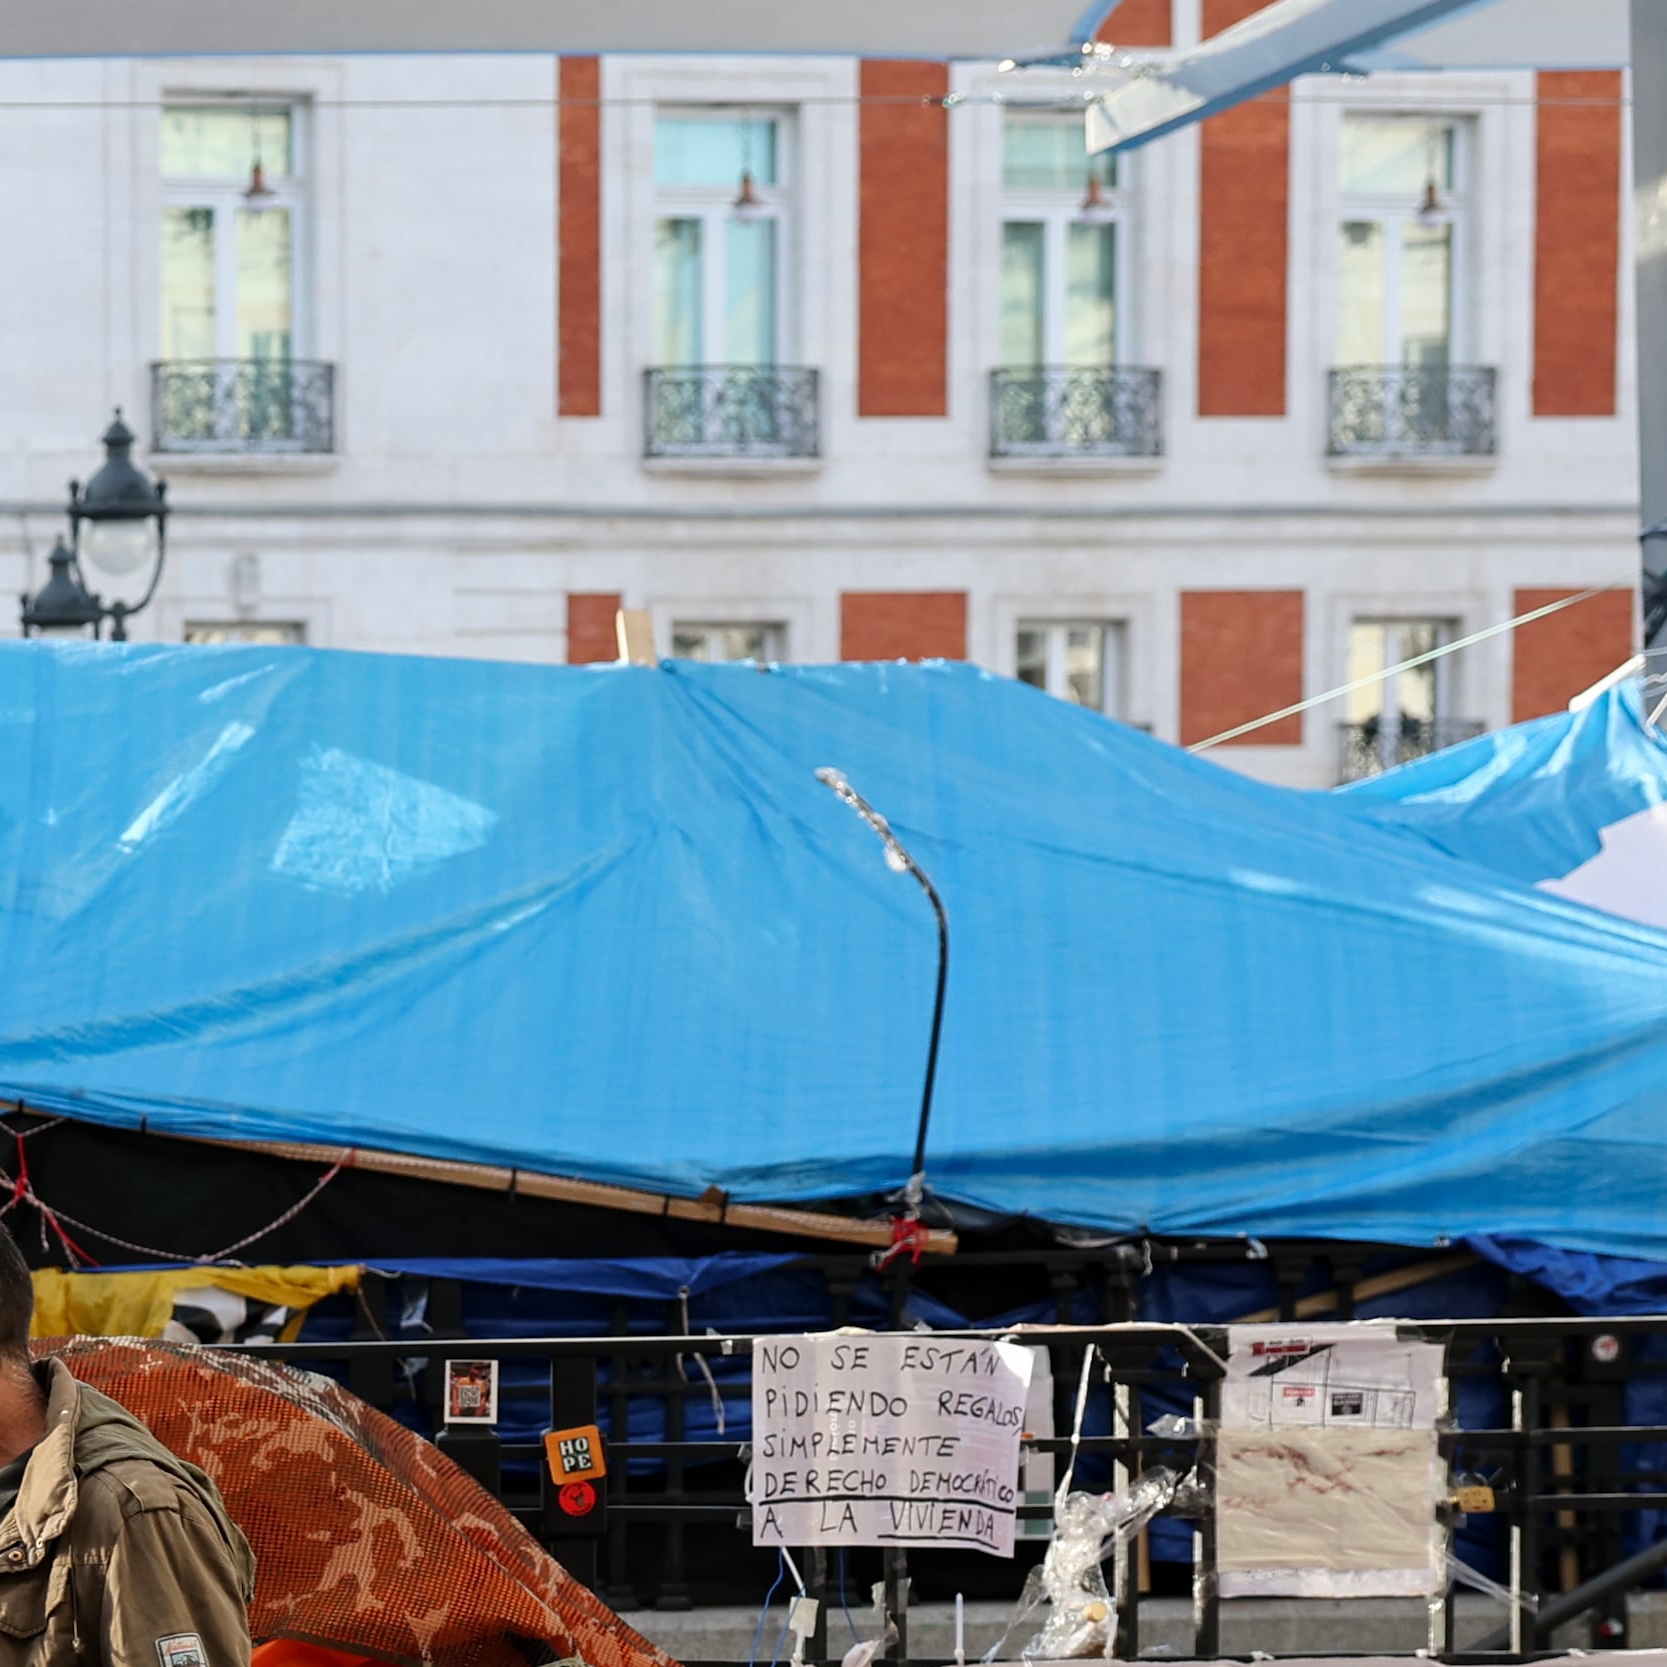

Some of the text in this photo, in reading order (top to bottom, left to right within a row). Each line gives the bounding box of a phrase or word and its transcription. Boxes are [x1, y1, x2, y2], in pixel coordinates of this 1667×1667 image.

[762, 1345, 1000, 1377] NO SE ESTÁN
[765, 1469, 887, 1498] DERECHO
[760, 1507, 784, 1539] A
[821, 1502, 858, 1533] LA
